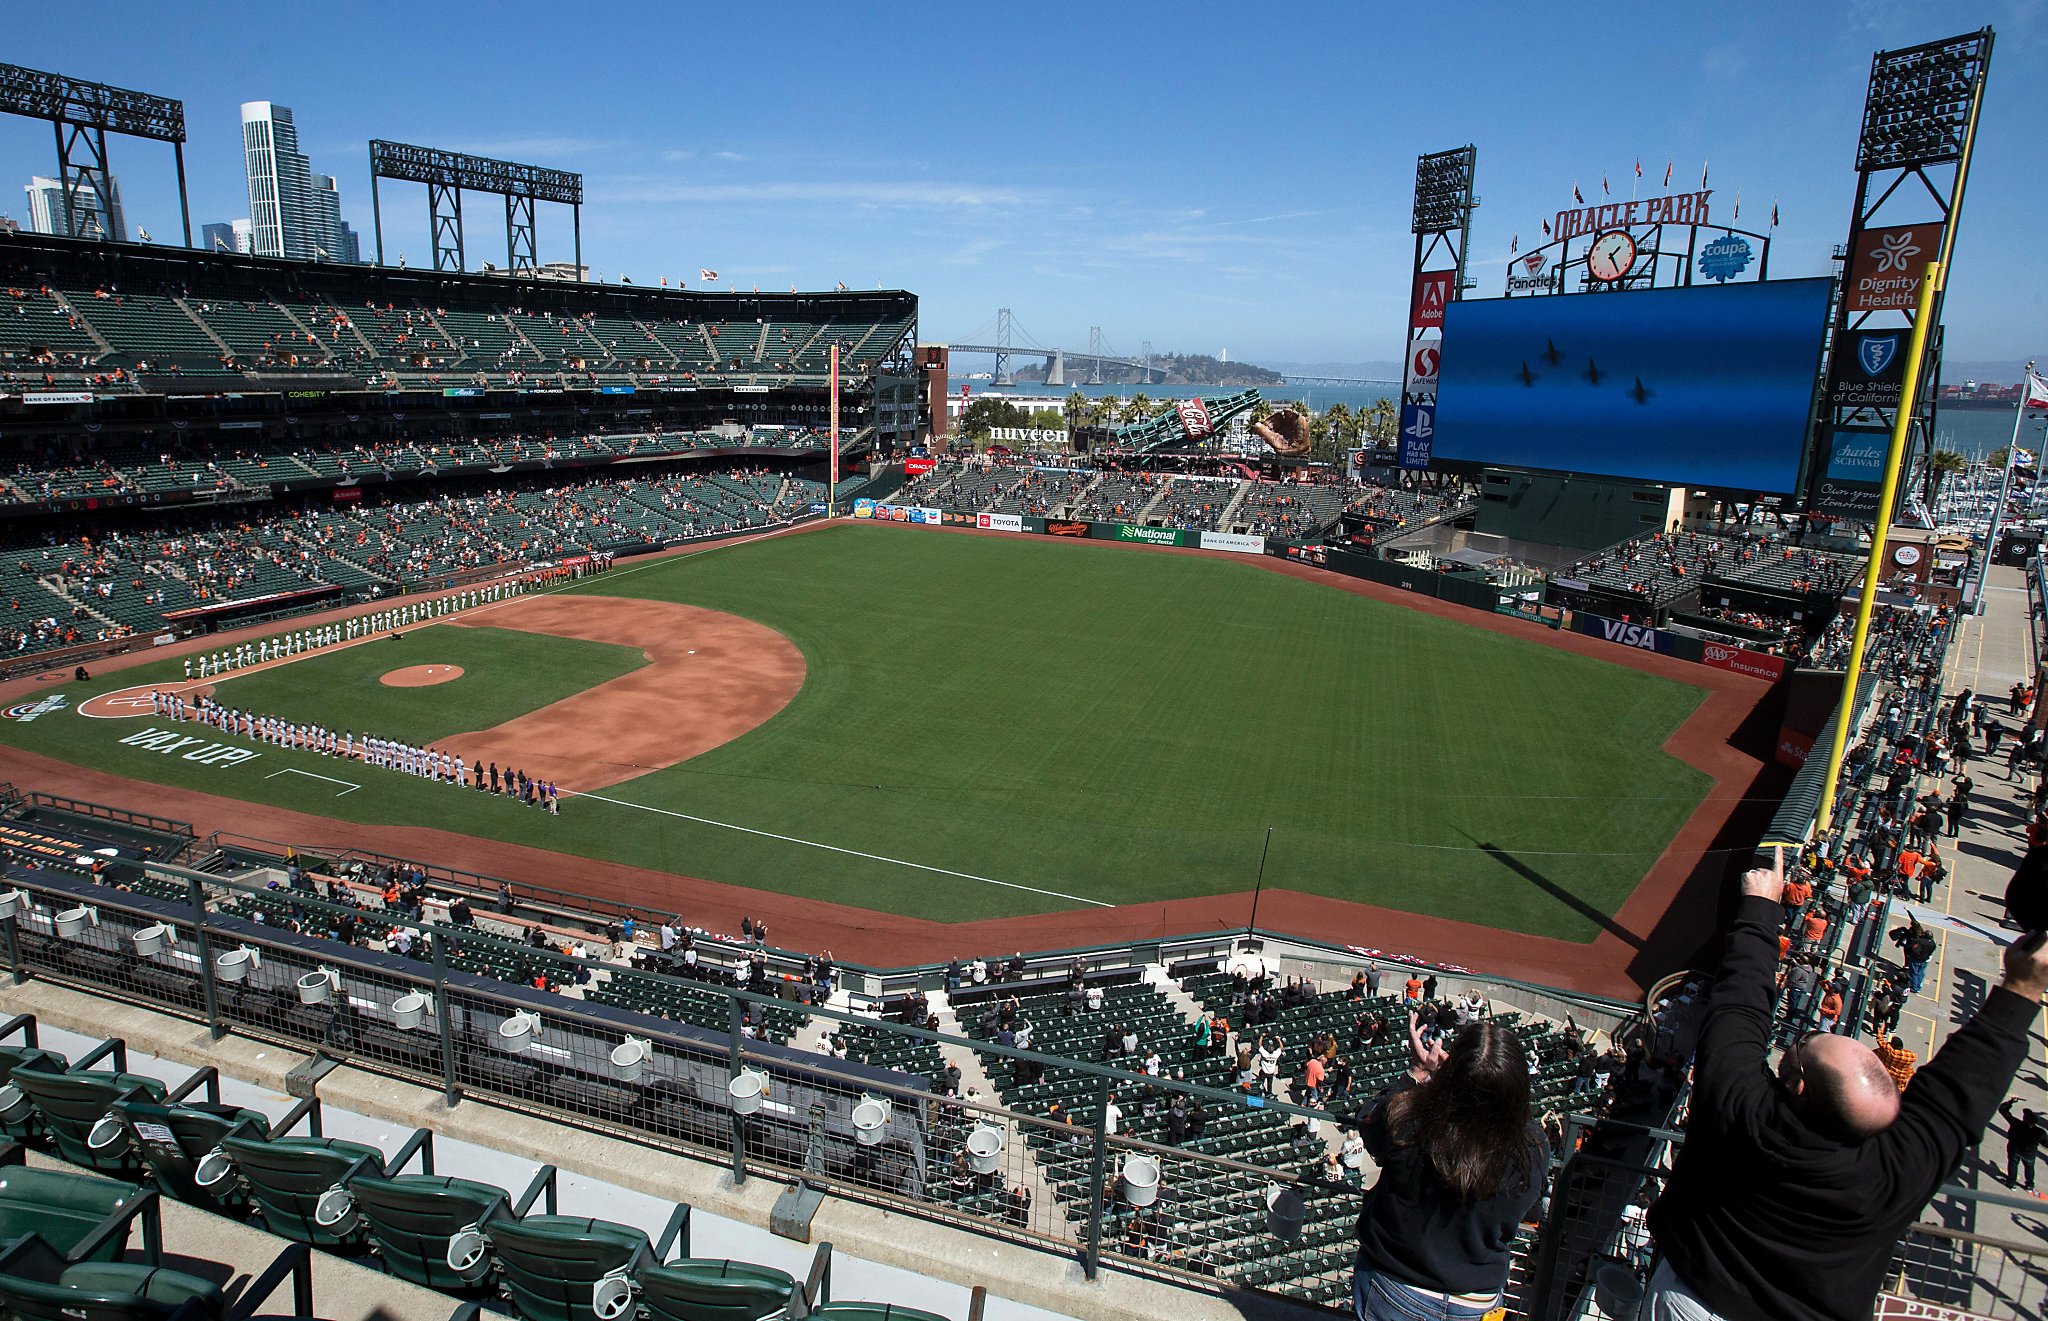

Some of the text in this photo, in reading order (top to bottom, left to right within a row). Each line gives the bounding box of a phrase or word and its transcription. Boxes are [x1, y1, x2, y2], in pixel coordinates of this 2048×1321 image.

[1553, 190, 1713, 243] ORACLE PARK
[1706, 243, 1748, 257] coupa
[1507, 277, 1557, 290] Fanatics
[1859, 276, 1920, 293] Dignity
[1859, 292, 1914, 307] Health
[1421, 309, 1442, 319] Adobe
[1412, 377, 1438, 385] SAFEWAY
[1839, 382, 1864, 391] Blue
[288, 391, 326, 399] COHESITY
[1833, 393, 1845, 402] of
[989, 427, 1069, 443] nuveen
[1407, 441, 1430, 452] PLAY
[1837, 445, 1883, 458] charles
[1406, 458, 1429, 466] LIMITS
[1835, 457, 1881, 468] SCHWAB
[1821, 483, 1849, 496] Own
[1818, 496, 1879, 510] tomorrow
[992, 518, 1020, 527] TOYOTA
[1133, 527, 1176, 540] National
[566, 557, 587, 565] ORACLE
[1510, 610, 1542, 623] HORNITOS
[1600, 619, 1655, 651] VISA
[1707, 646, 1726, 658] AAA
[1730, 660, 1778, 678] Insurance
[118, 727, 262, 768] VAX UP!
[817, 1042, 826, 1051] 26
[1905, 1301, 1988, 1321] PLEA
